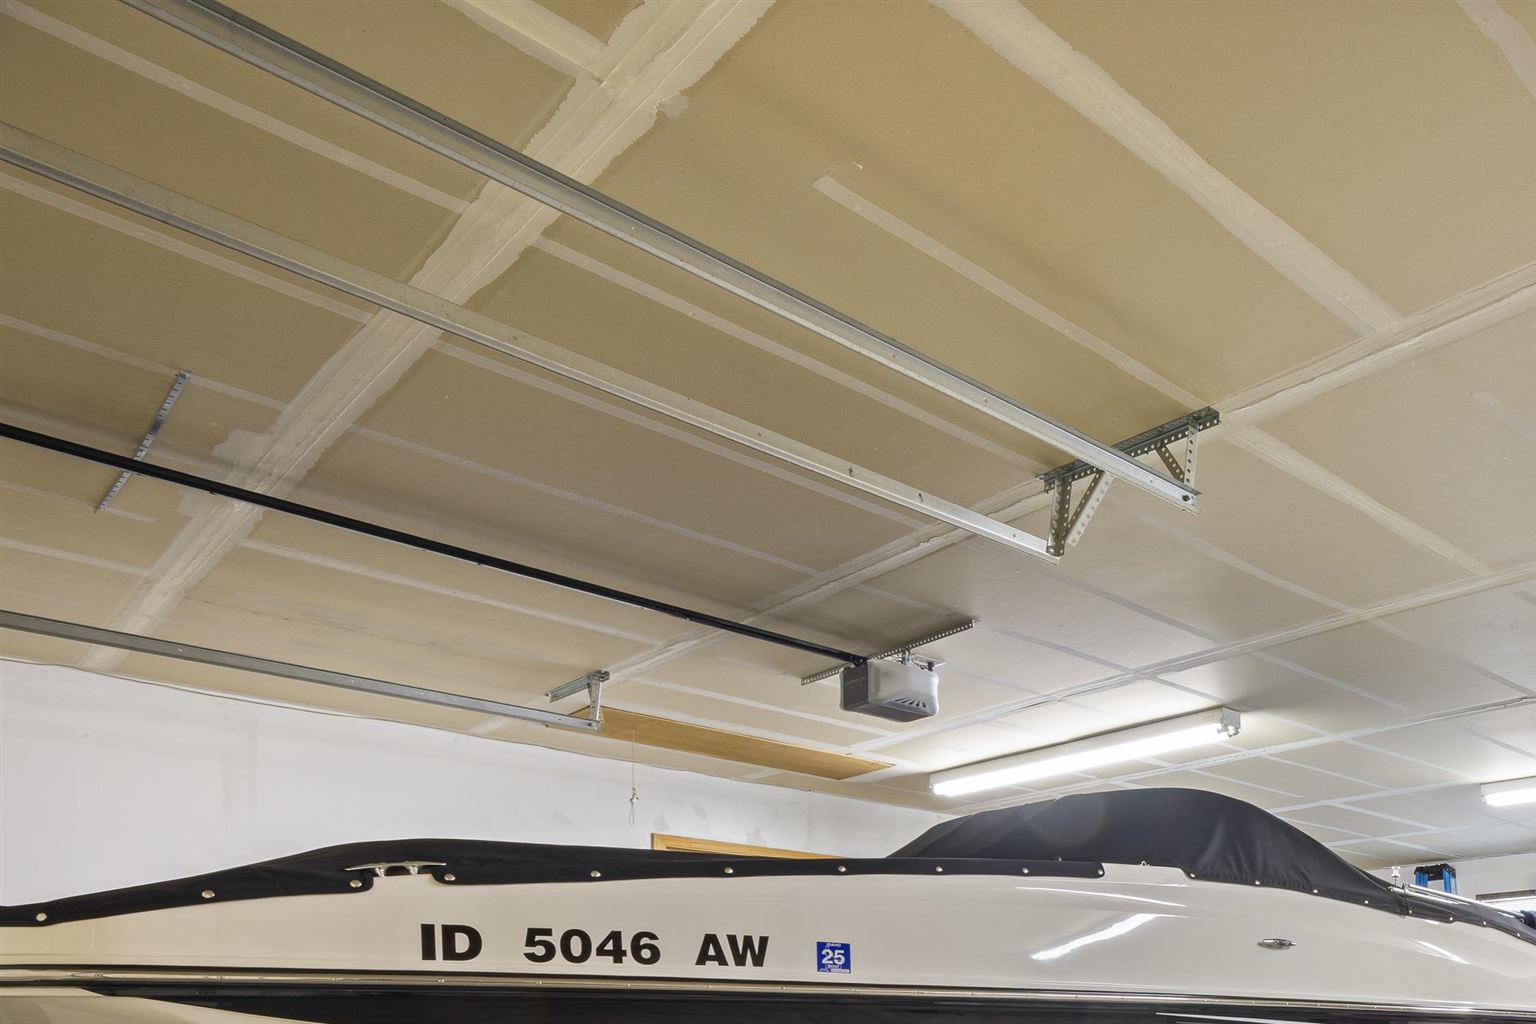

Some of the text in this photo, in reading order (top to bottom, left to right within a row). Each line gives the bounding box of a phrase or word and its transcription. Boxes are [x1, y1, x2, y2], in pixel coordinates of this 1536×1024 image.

[420, 923, 770, 967] ID 5046 AW
[821, 949, 846, 965] 25
